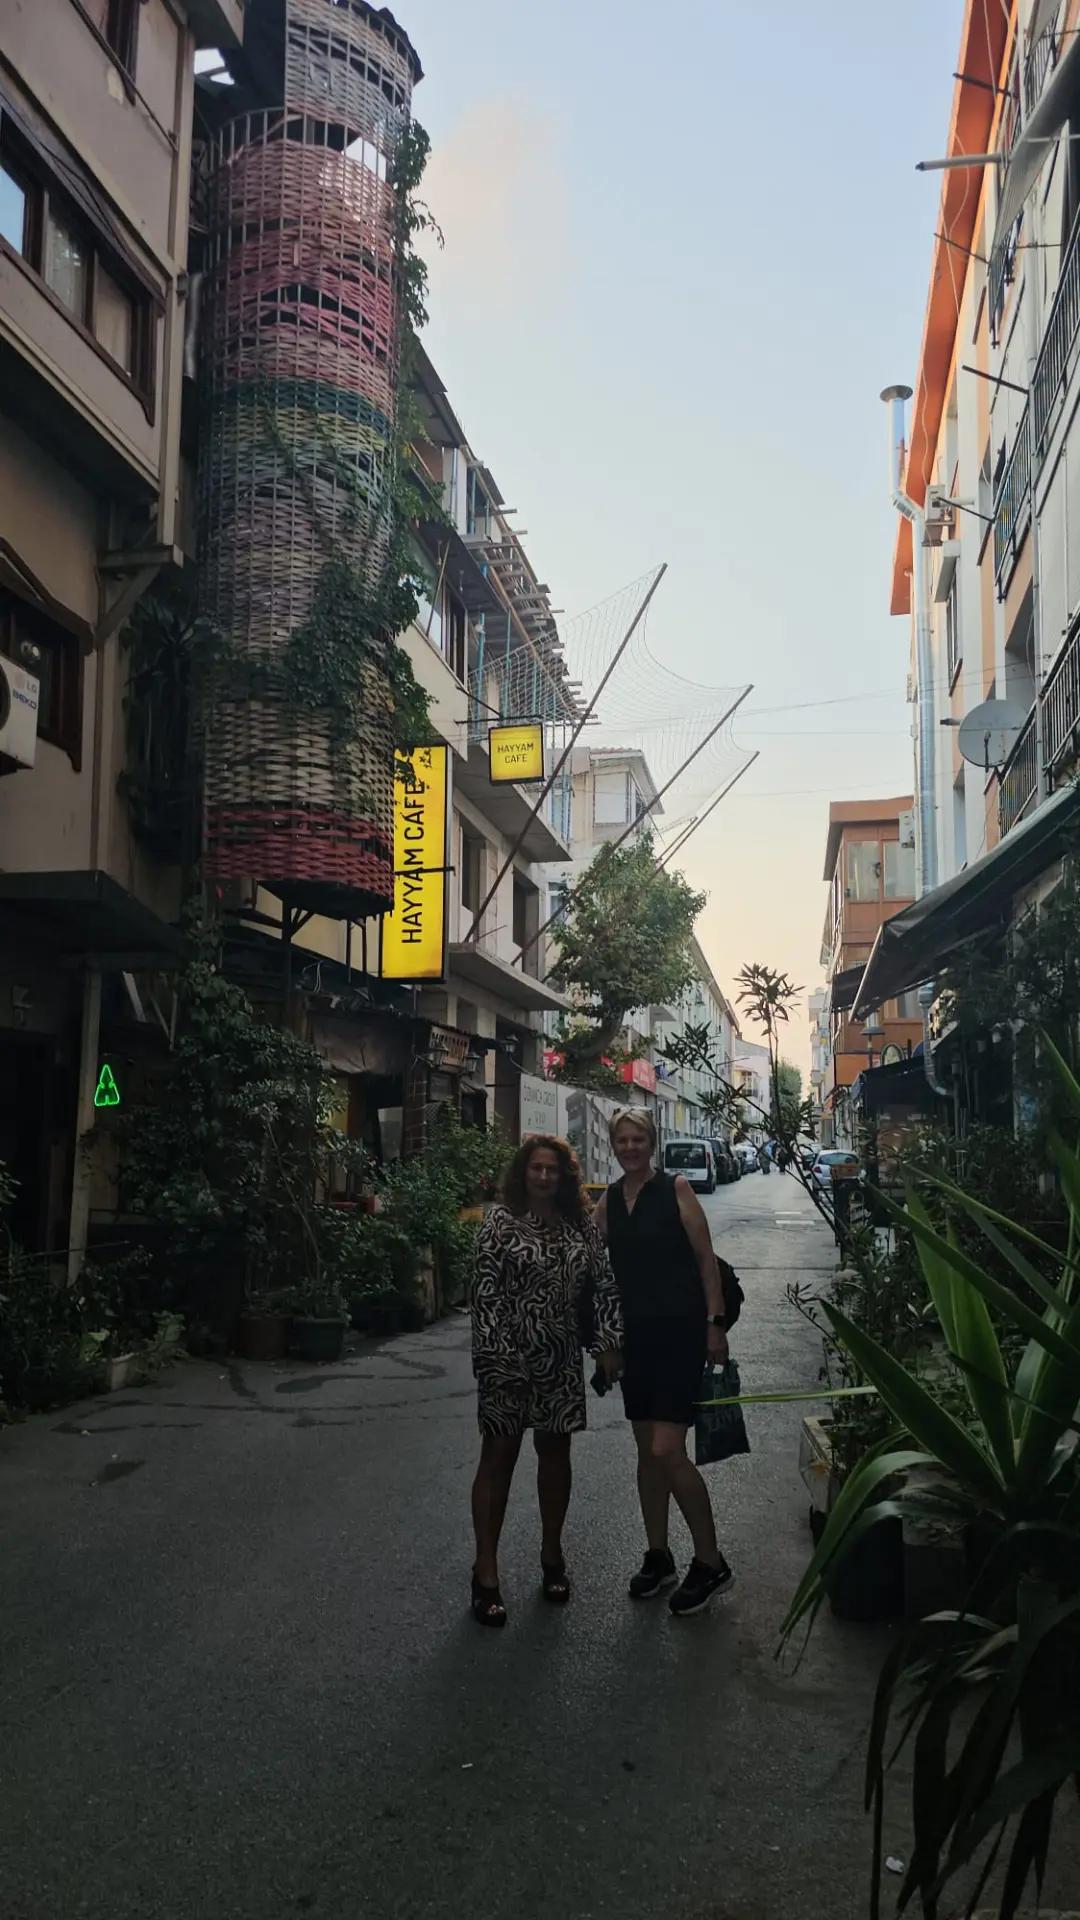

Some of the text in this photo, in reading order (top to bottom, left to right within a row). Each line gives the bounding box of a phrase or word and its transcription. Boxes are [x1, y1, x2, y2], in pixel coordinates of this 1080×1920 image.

[497, 742, 534, 754] HAYYAM
[504, 753, 528, 764] CAFE
[401, 783, 425, 944] HAYYAM CAFE
